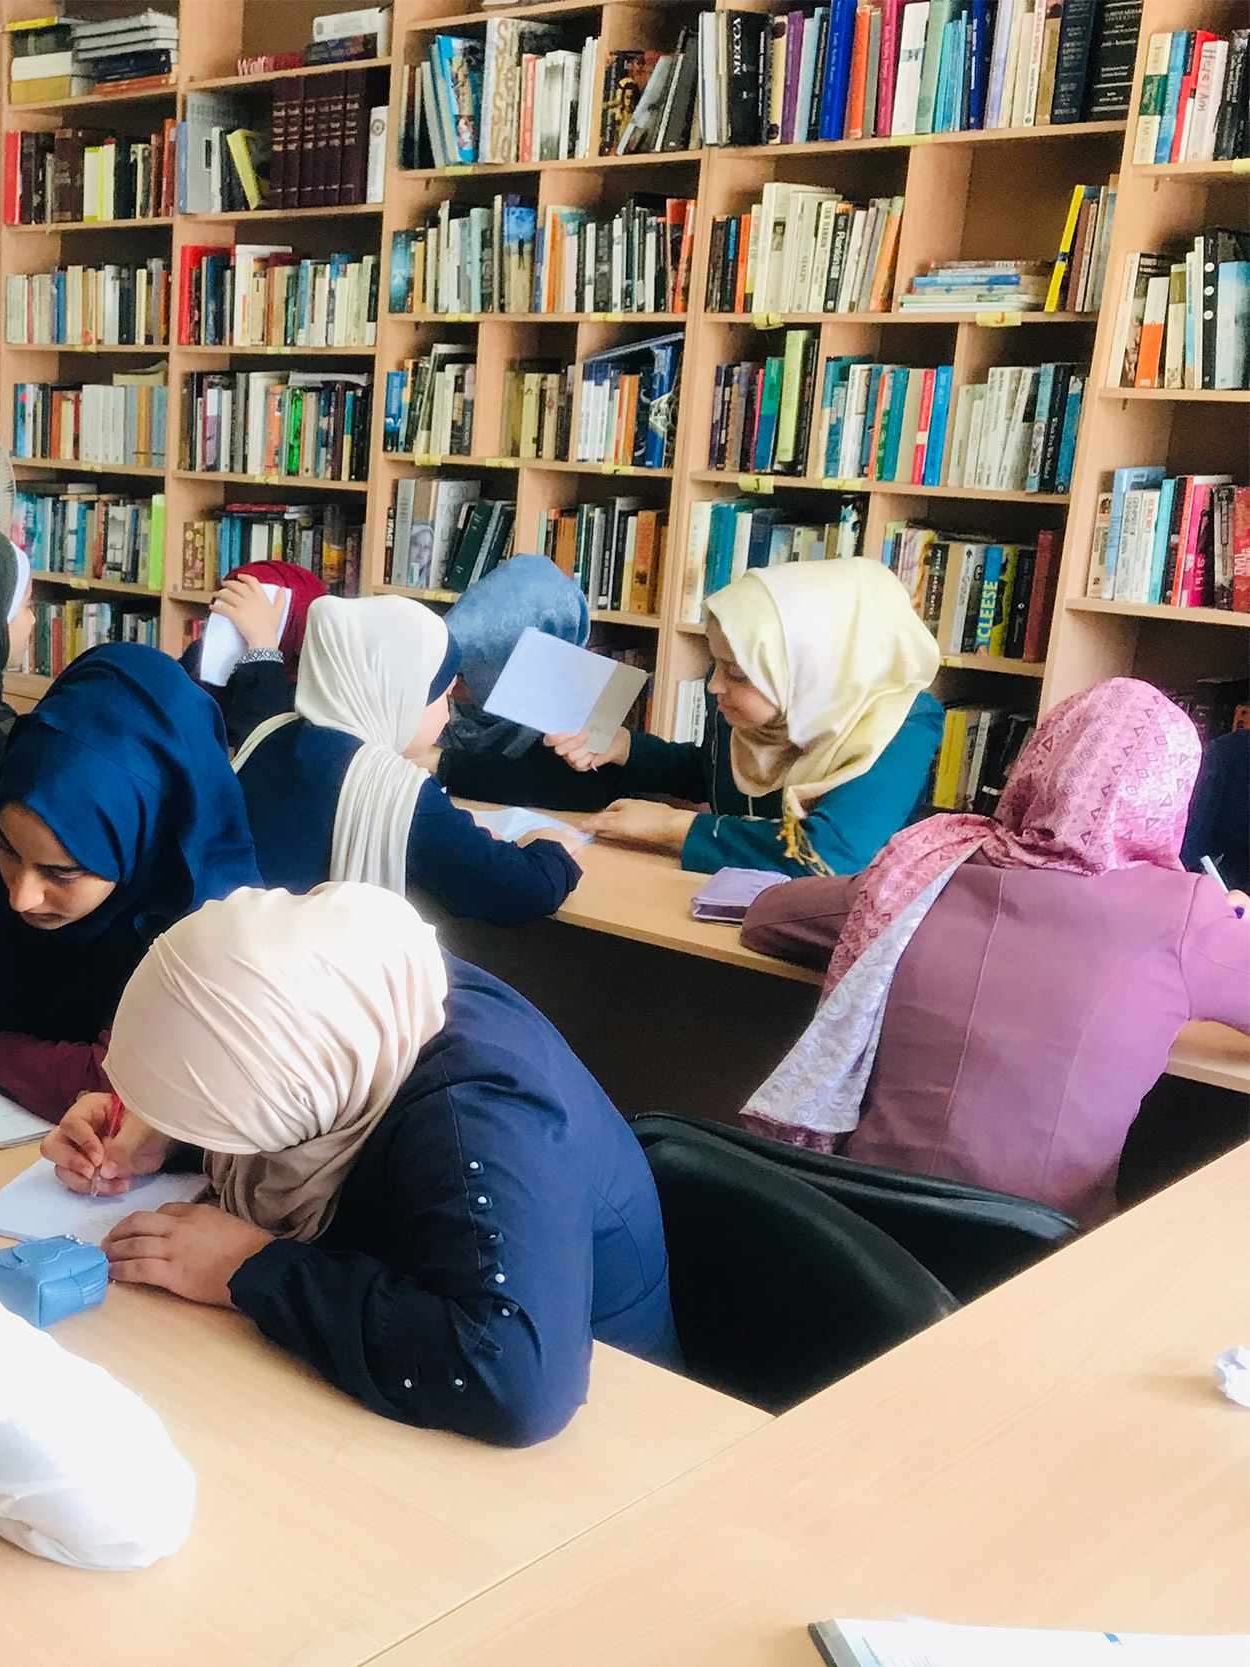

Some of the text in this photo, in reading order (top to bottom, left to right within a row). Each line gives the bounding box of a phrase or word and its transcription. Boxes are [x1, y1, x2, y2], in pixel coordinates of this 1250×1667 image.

[732, 17, 743, 75] MECCA
[1201, 49, 1217, 81] Here
[1196, 93, 1210, 111] Am
[386, 523, 394, 547] FACE
[976, 581, 998, 638] CLEESE
